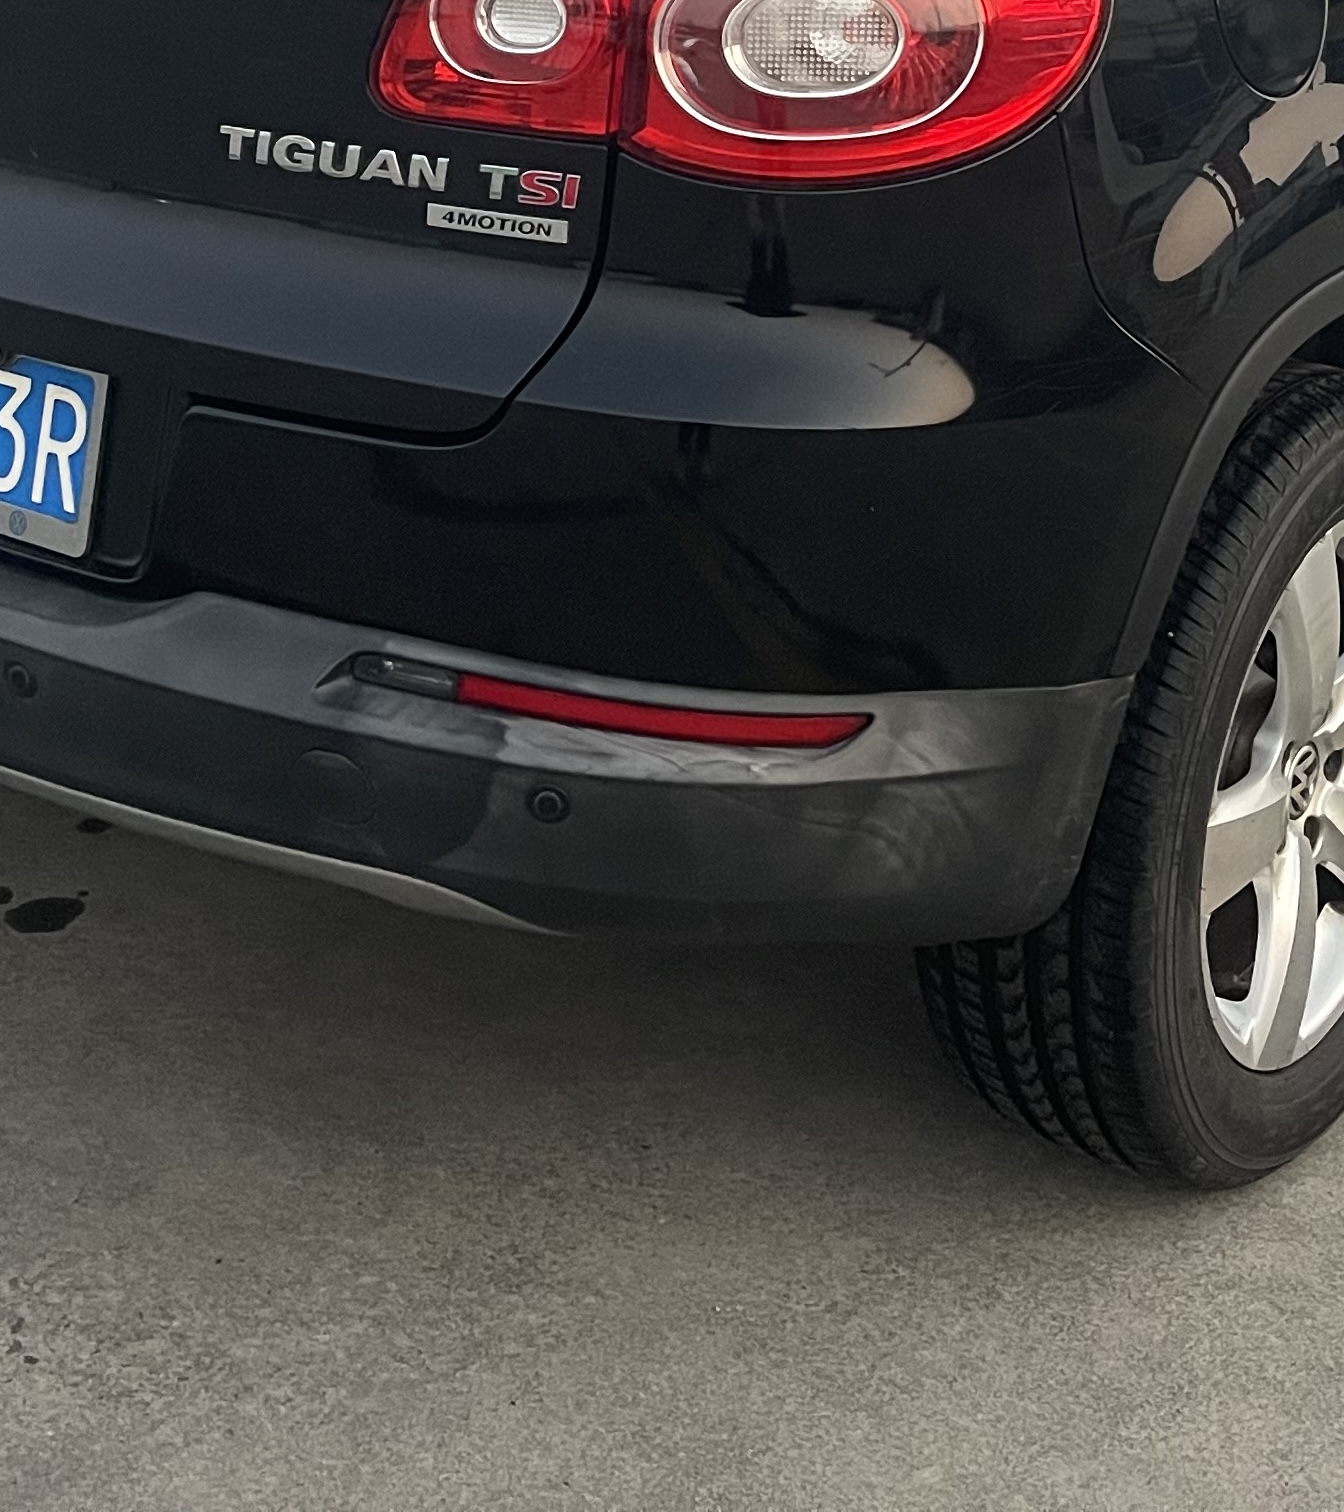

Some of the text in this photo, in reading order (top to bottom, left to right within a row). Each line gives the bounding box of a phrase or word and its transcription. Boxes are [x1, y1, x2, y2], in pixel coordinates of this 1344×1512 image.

[219, 125, 582, 209] TIGUAN TSI
[441, 210, 553, 238] 4MOTION
